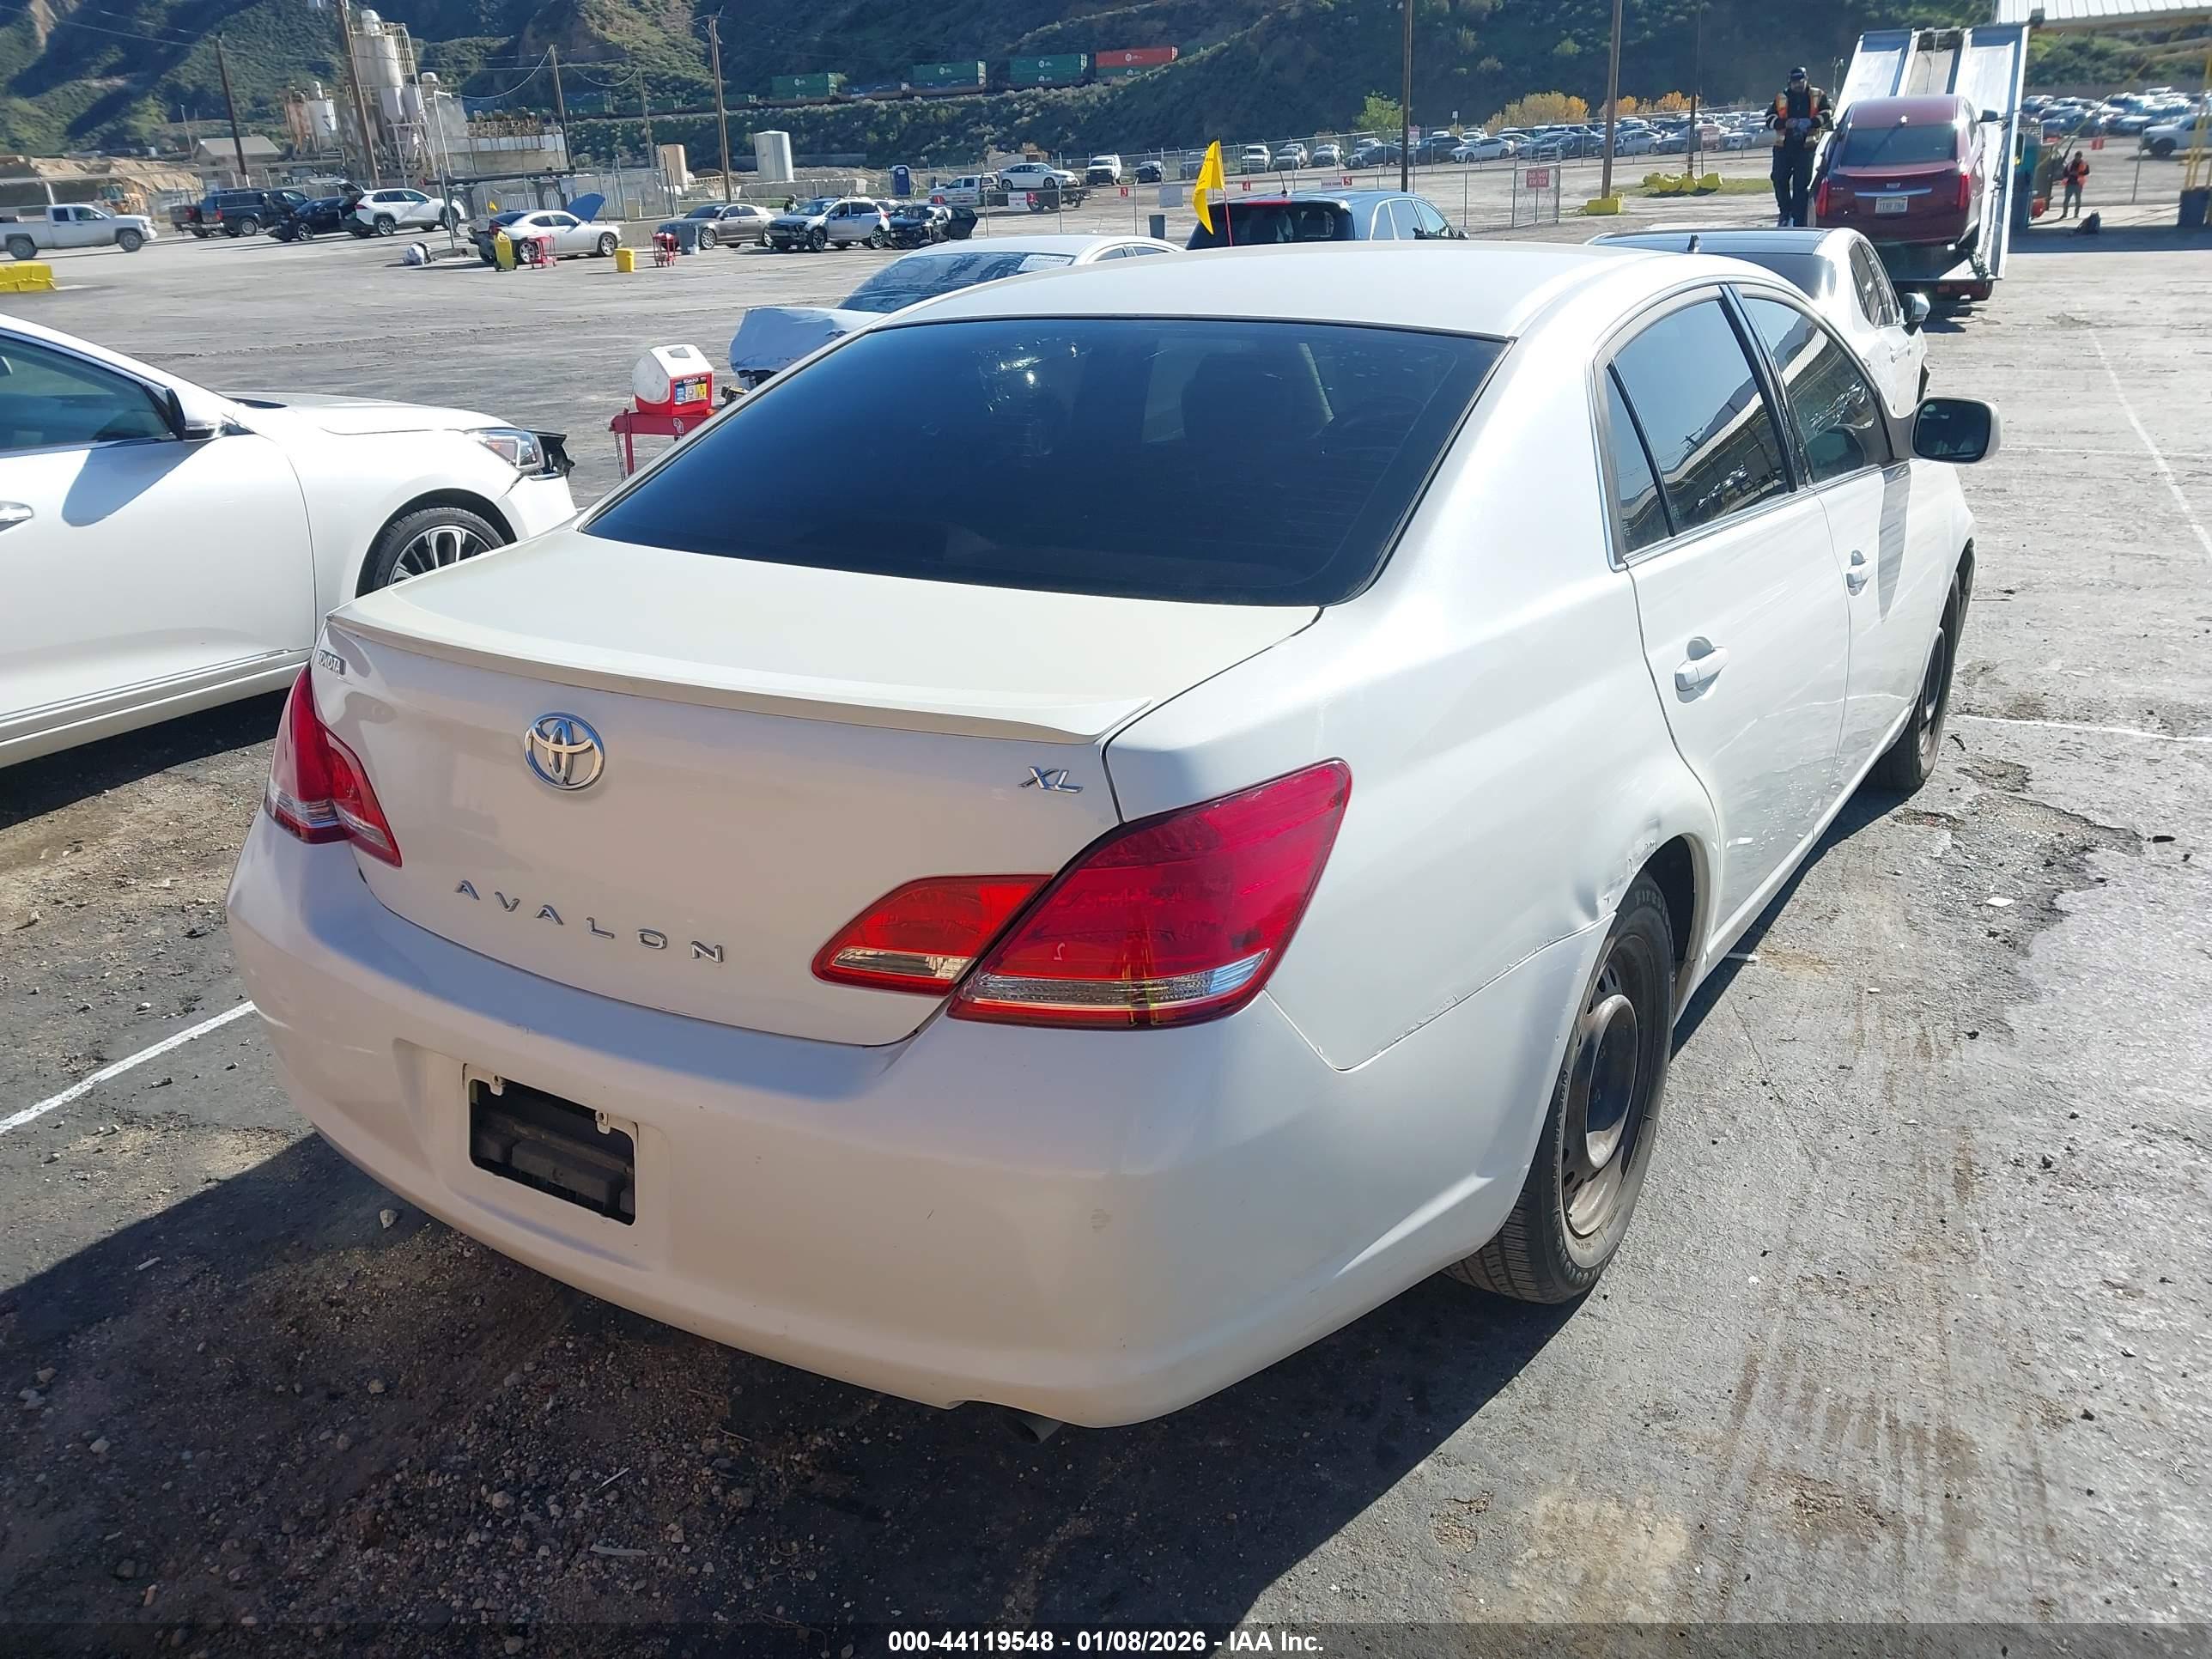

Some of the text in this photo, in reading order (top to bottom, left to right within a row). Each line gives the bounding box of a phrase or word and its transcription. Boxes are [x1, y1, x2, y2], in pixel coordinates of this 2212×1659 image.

[317, 650, 341, 674] TOYOTA
[1018, 766, 1084, 793] XL
[453, 879, 724, 963] AVALON
